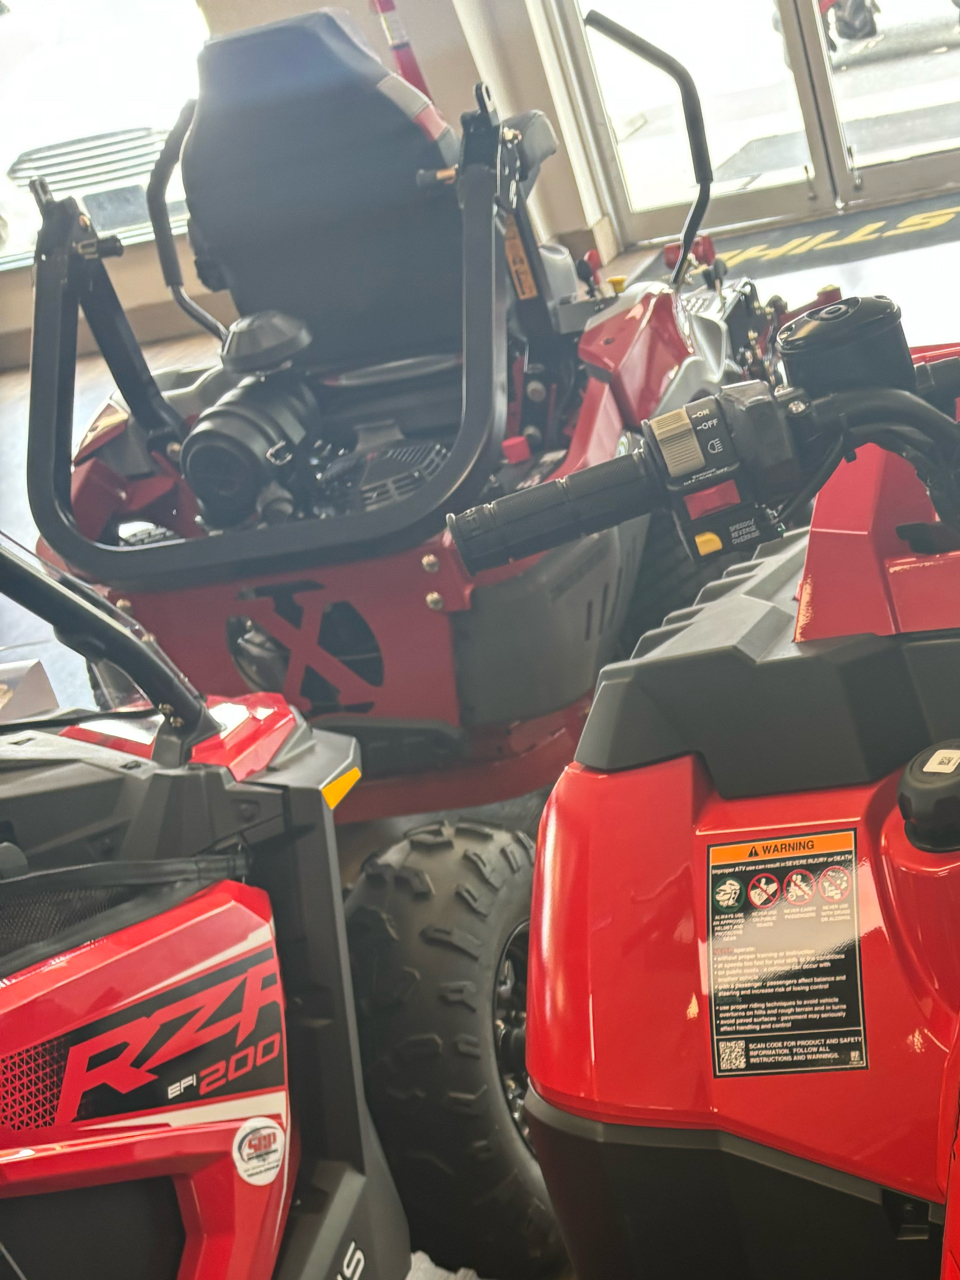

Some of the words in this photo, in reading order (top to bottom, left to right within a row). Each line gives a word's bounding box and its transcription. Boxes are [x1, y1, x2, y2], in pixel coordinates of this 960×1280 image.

[702, 418, 718, 430] OFF
[762, 840, 814, 854] WARNING
[168, 1074, 197, 1099] EFI
[199, 1033, 281, 1096] 200
